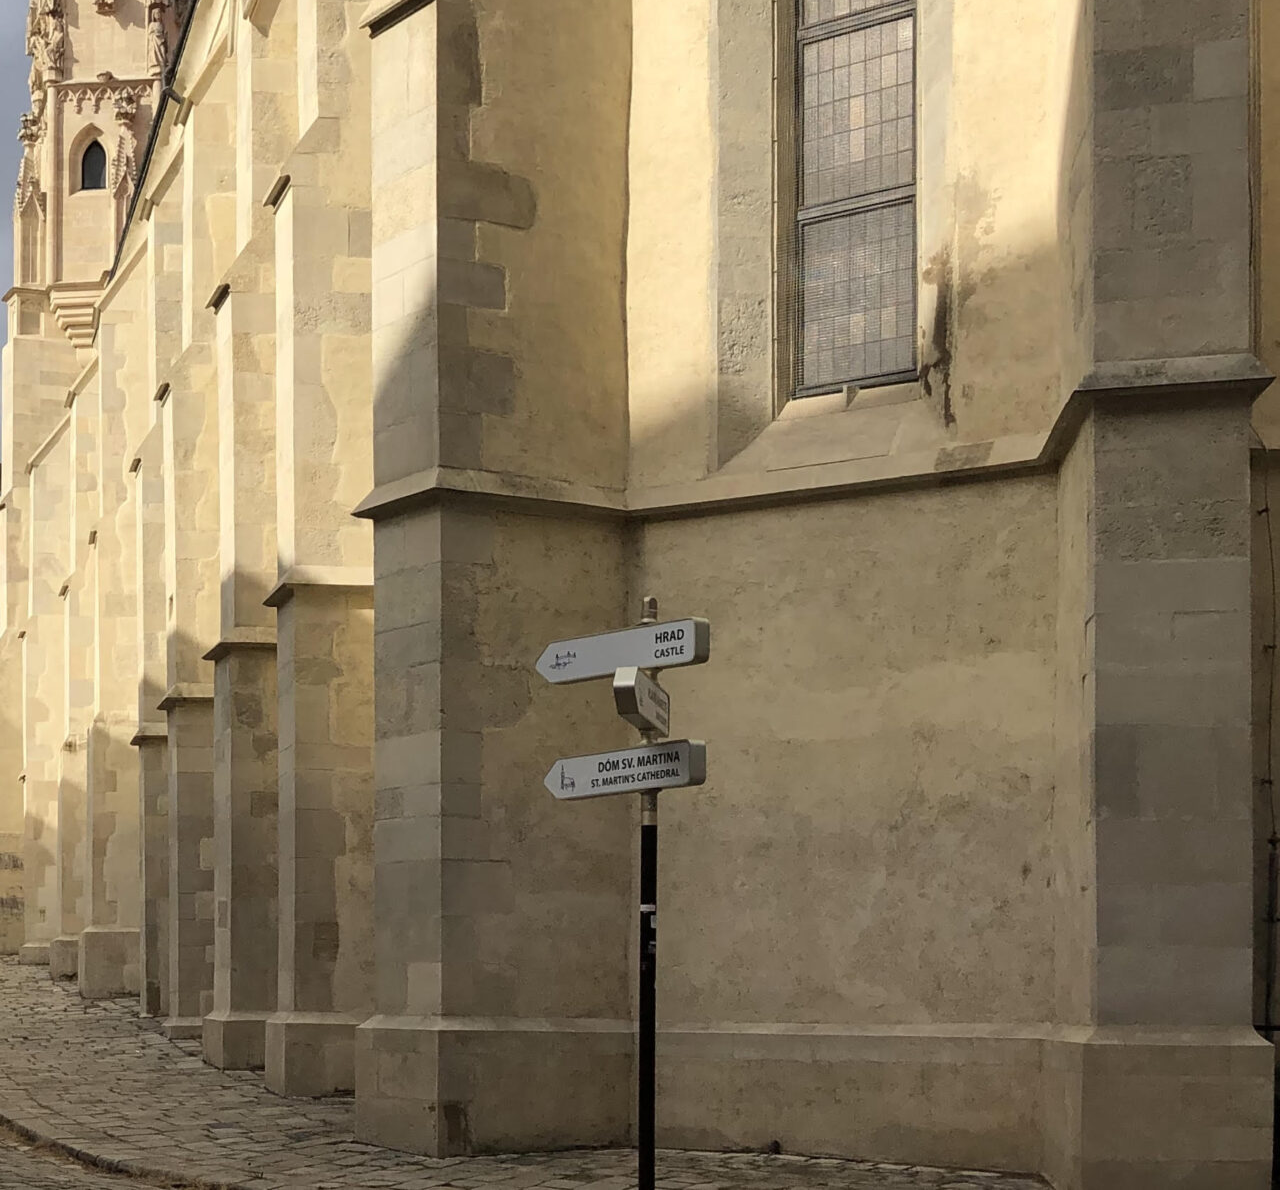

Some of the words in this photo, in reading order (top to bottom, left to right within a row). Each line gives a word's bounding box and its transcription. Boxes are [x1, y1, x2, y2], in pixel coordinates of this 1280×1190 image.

[655, 628, 685, 644] HRAD
[654, 645, 685, 659] CASTLE
[598, 758, 620, 773] DÓM
[621, 757, 635, 770] SV.
[637, 751, 680, 768] MARTINA
[591, 778, 601, 788] ST.
[602, 773, 635, 787] MARTIN'S
[636, 768, 680, 782] CATHEDRAL
